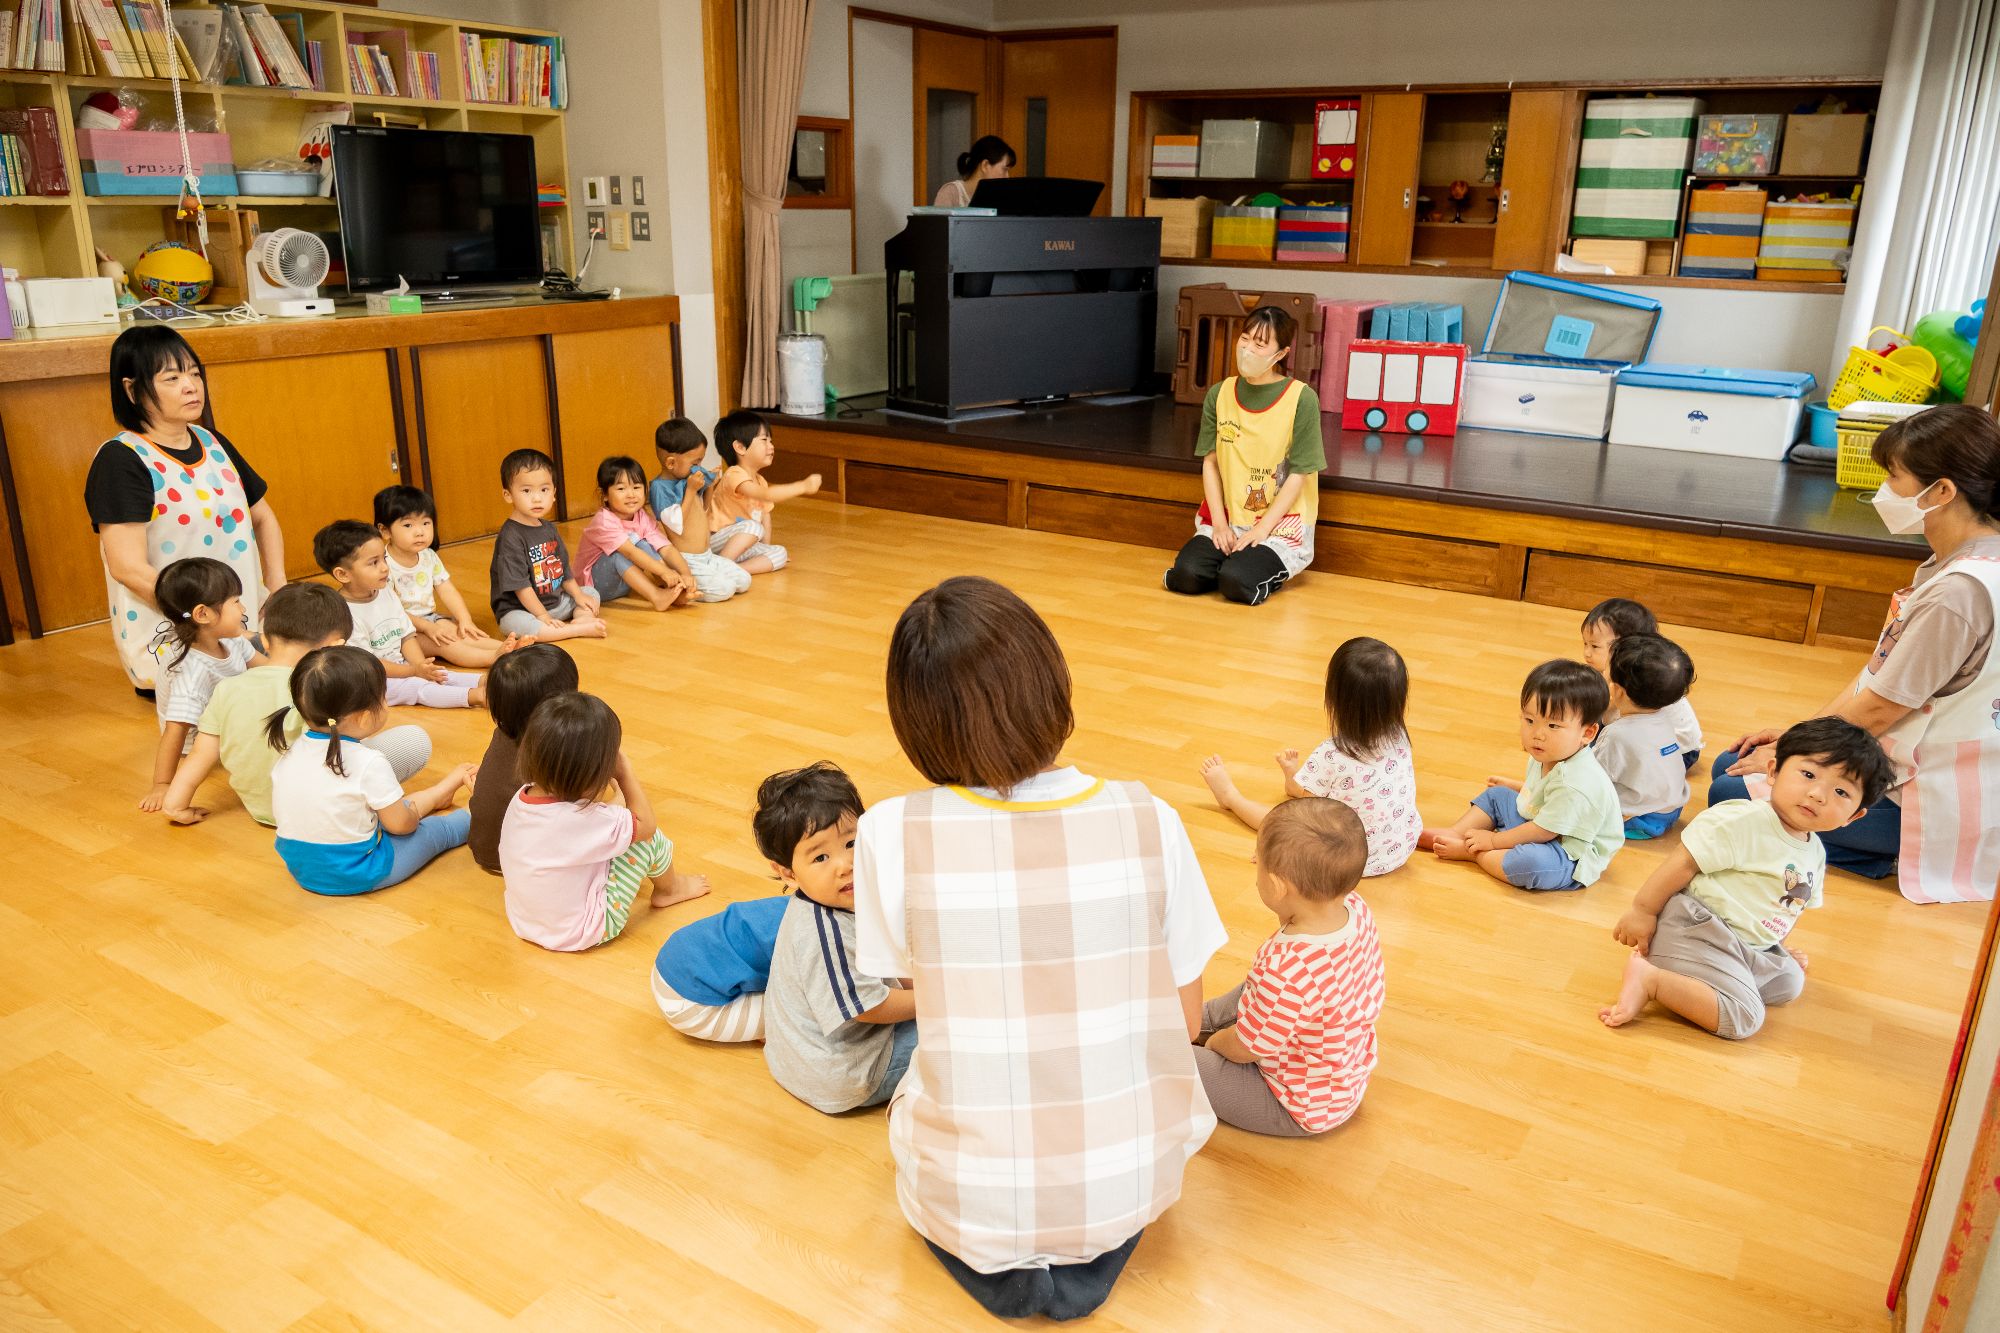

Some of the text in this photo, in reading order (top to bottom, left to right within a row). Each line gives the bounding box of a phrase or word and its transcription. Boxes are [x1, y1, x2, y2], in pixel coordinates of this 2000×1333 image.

[126, 164, 201, 175] エプロンシアー
[1044, 240, 1075, 251] KAWAI
[1250, 467, 1261, 475] TOM
[1249, 474, 1265, 482] JERRY
